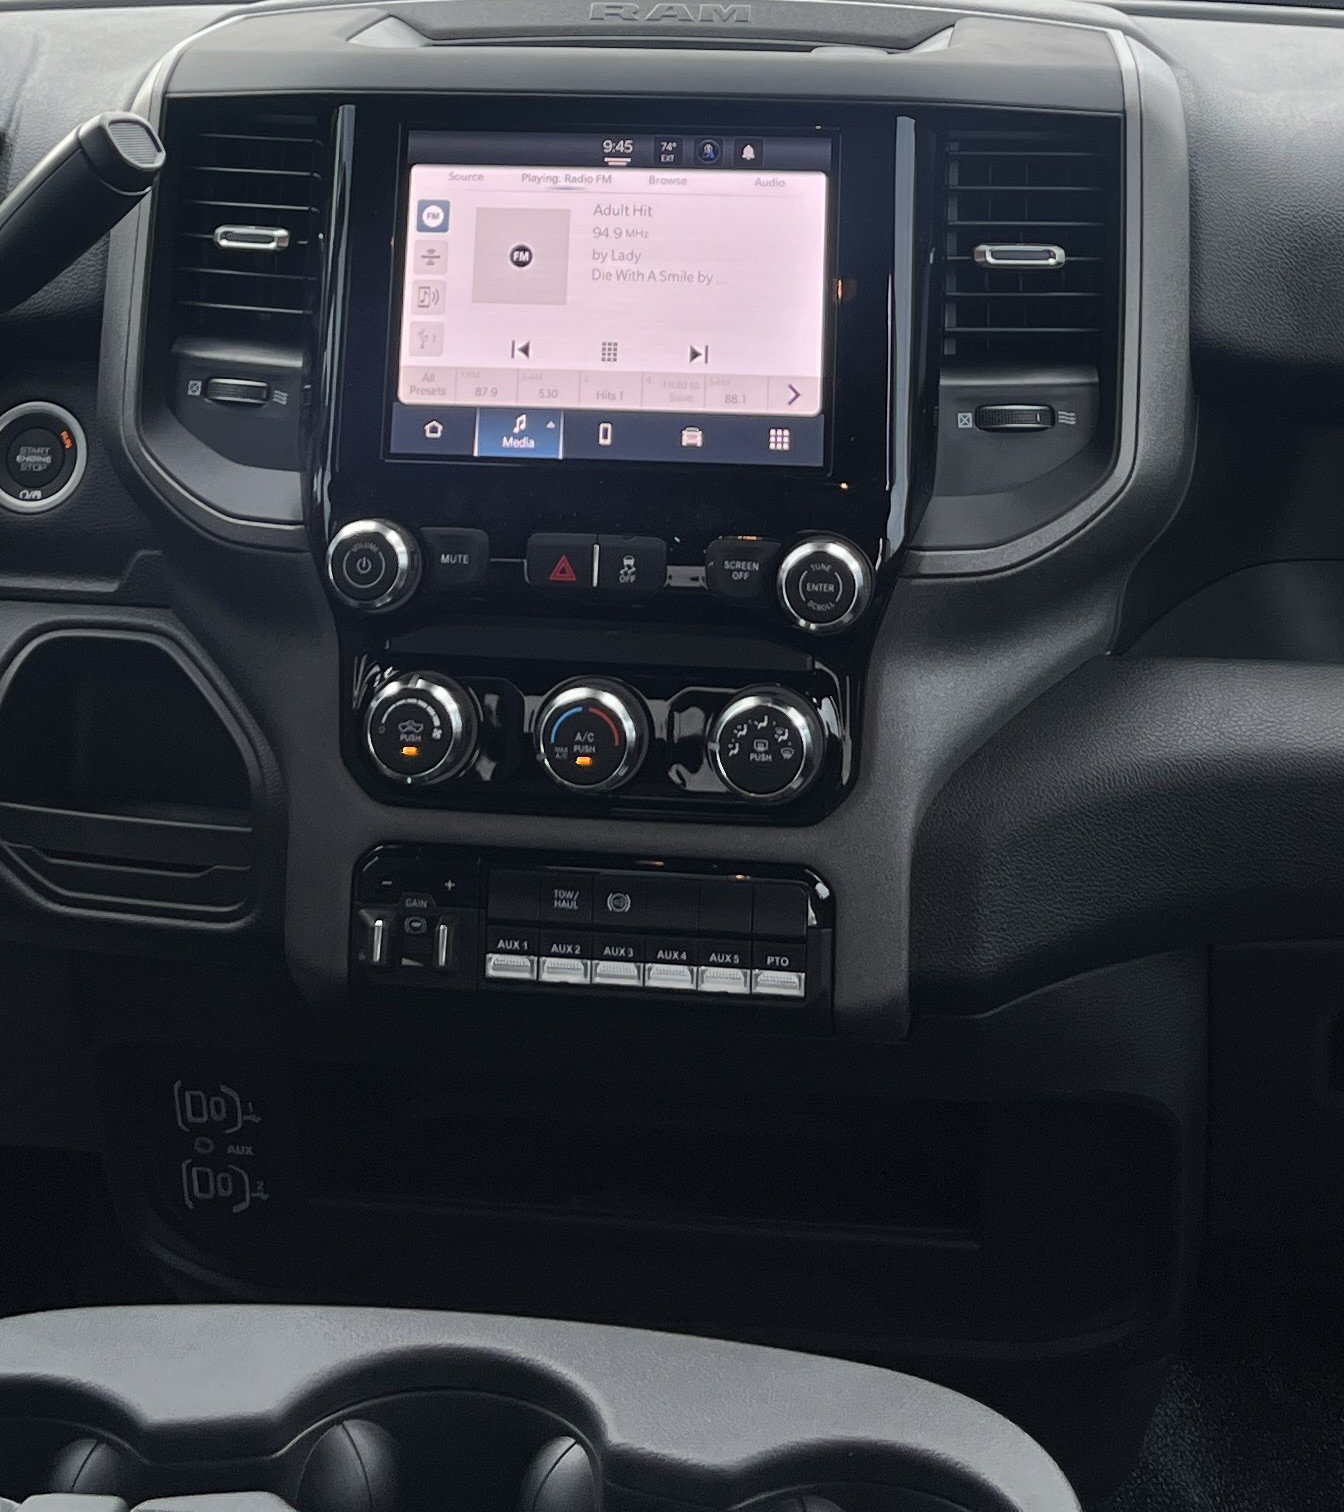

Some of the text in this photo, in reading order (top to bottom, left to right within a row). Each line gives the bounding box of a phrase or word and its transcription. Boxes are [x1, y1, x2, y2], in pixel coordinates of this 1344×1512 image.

[589, 1, 752, 25] RAM
[603, 139, 634, 154] 9:45
[660, 154, 674, 164] EXT
[448, 172, 485, 183] Source
[564, 174, 593, 185] Radio
[595, 174, 612, 185] FM
[648, 176, 687, 186] Browse
[754, 178, 786, 188] Audio
[426, 211, 440, 221] FM
[593, 205, 653, 218] Adult Hit
[625, 229, 650, 239] MHz
[513, 251, 530, 262] FM
[592, 249, 642, 265] by Lady
[591, 269, 713, 286] Die With A Smile by
[421, 372, 435, 383] All
[663, 379, 700, 390] Hold to
[409, 385, 446, 396] Presets
[538, 388, 559, 399] 530
[596, 390, 616, 401] Hits
[724, 394, 747, 405] 88.1
[502, 436, 535, 449] Media
[440, 552, 469, 565] MUTE
[723, 559, 760, 572] SCREEN
[809, 562, 832, 574] TUNE
[619, 573, 636, 583] OFF
[731, 570, 750, 581] OFF
[806, 582, 835, 593] ENTER
[806, 600, 836, 613] SCROLL
[399, 732, 422, 743] PUSH
[574, 729, 595, 744] A/C
[573, 743, 596, 754] PUSH
[749, 752, 772, 764] PUSH
[553, 889, 580, 900] TOW/
[405, 898, 427, 908] GAIN
[553, 899, 579, 911] HAUL
[497, 939, 529, 951] AUX 1
[551, 944, 582, 955] AUX 2
[603, 946, 634, 958] AUX 3
[657, 950, 687, 961] AUX 4
[709, 952, 740, 964] AUX 5
[766, 955, 790, 967] PTO
[227, 1144, 255, 1156] AUX
